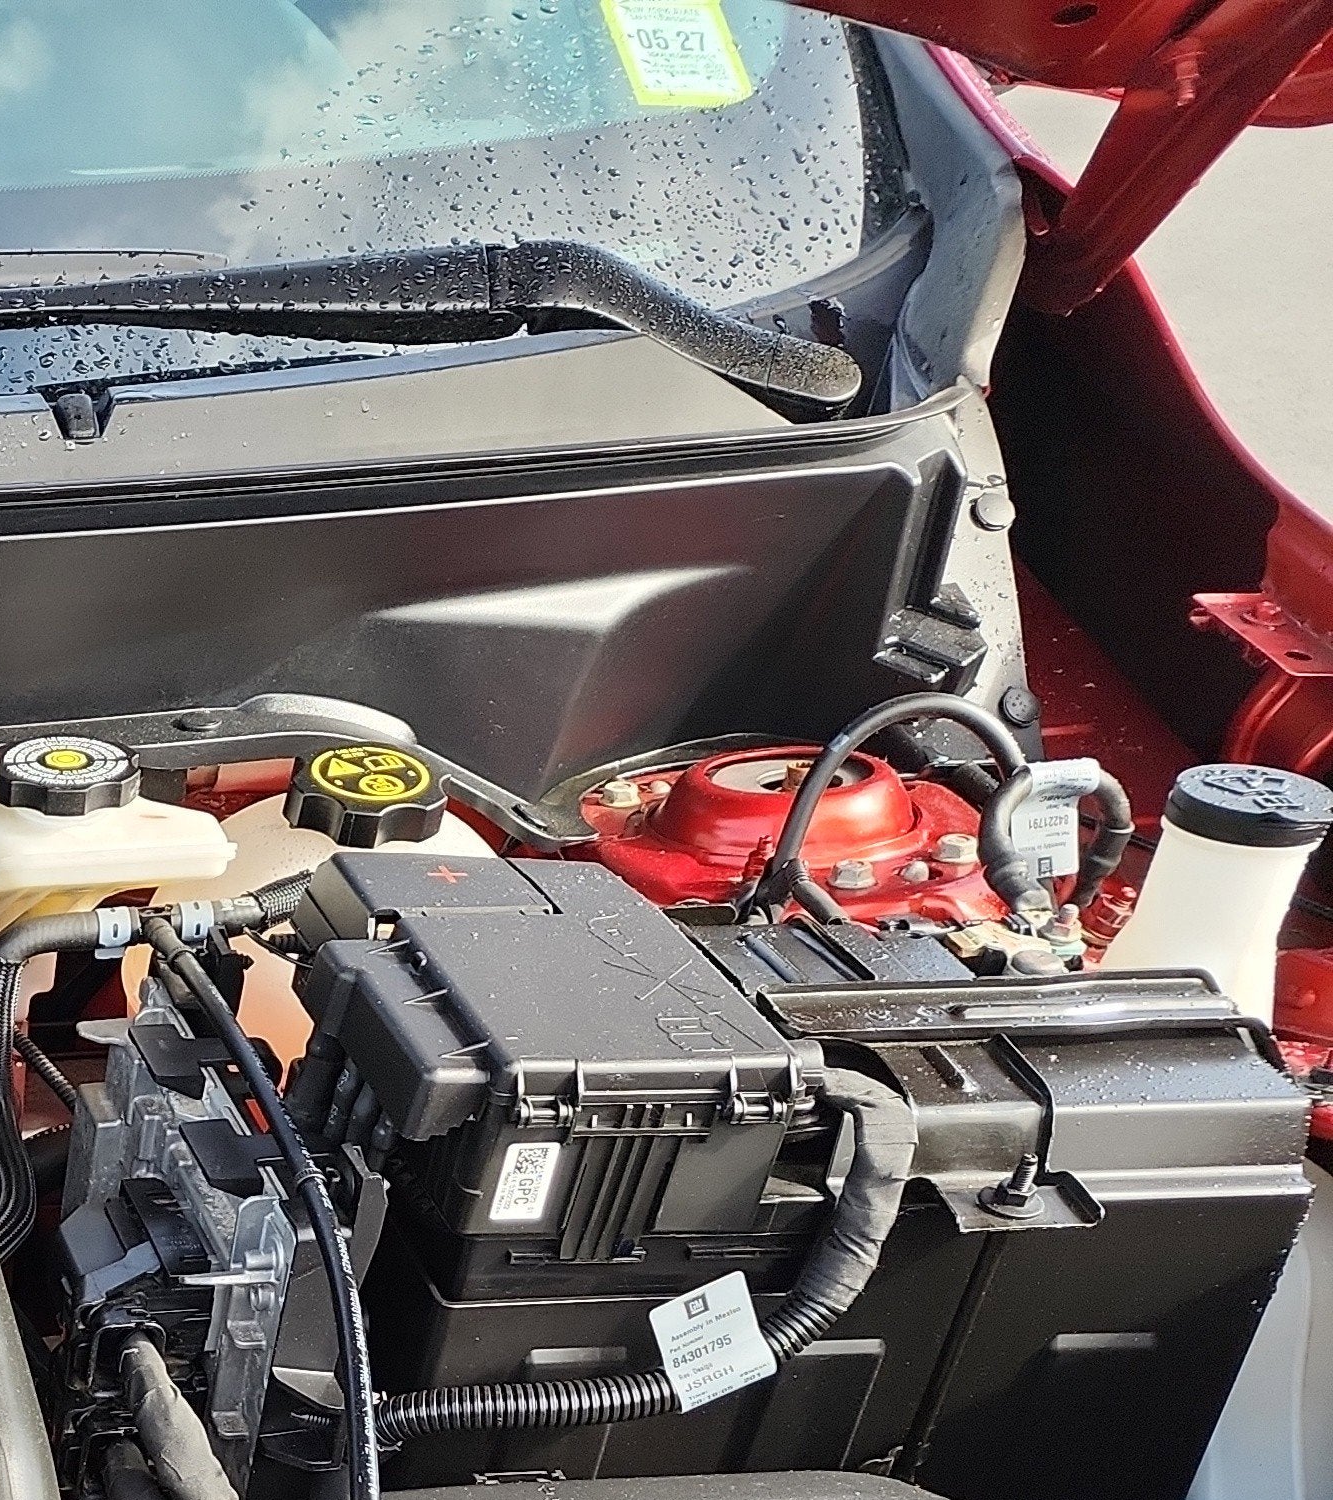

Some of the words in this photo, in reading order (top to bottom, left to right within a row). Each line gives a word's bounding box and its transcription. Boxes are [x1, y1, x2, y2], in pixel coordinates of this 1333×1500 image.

[637, 28, 669, 50] 05
[676, 30, 705, 51] 27
[1029, 814, 1069, 830] 84221791
[513, 1178, 534, 1205] GPC
[671, 1324, 704, 1342] Assembly
[706, 1317, 714, 1326] in
[672, 1334, 732, 1369] 84301795
